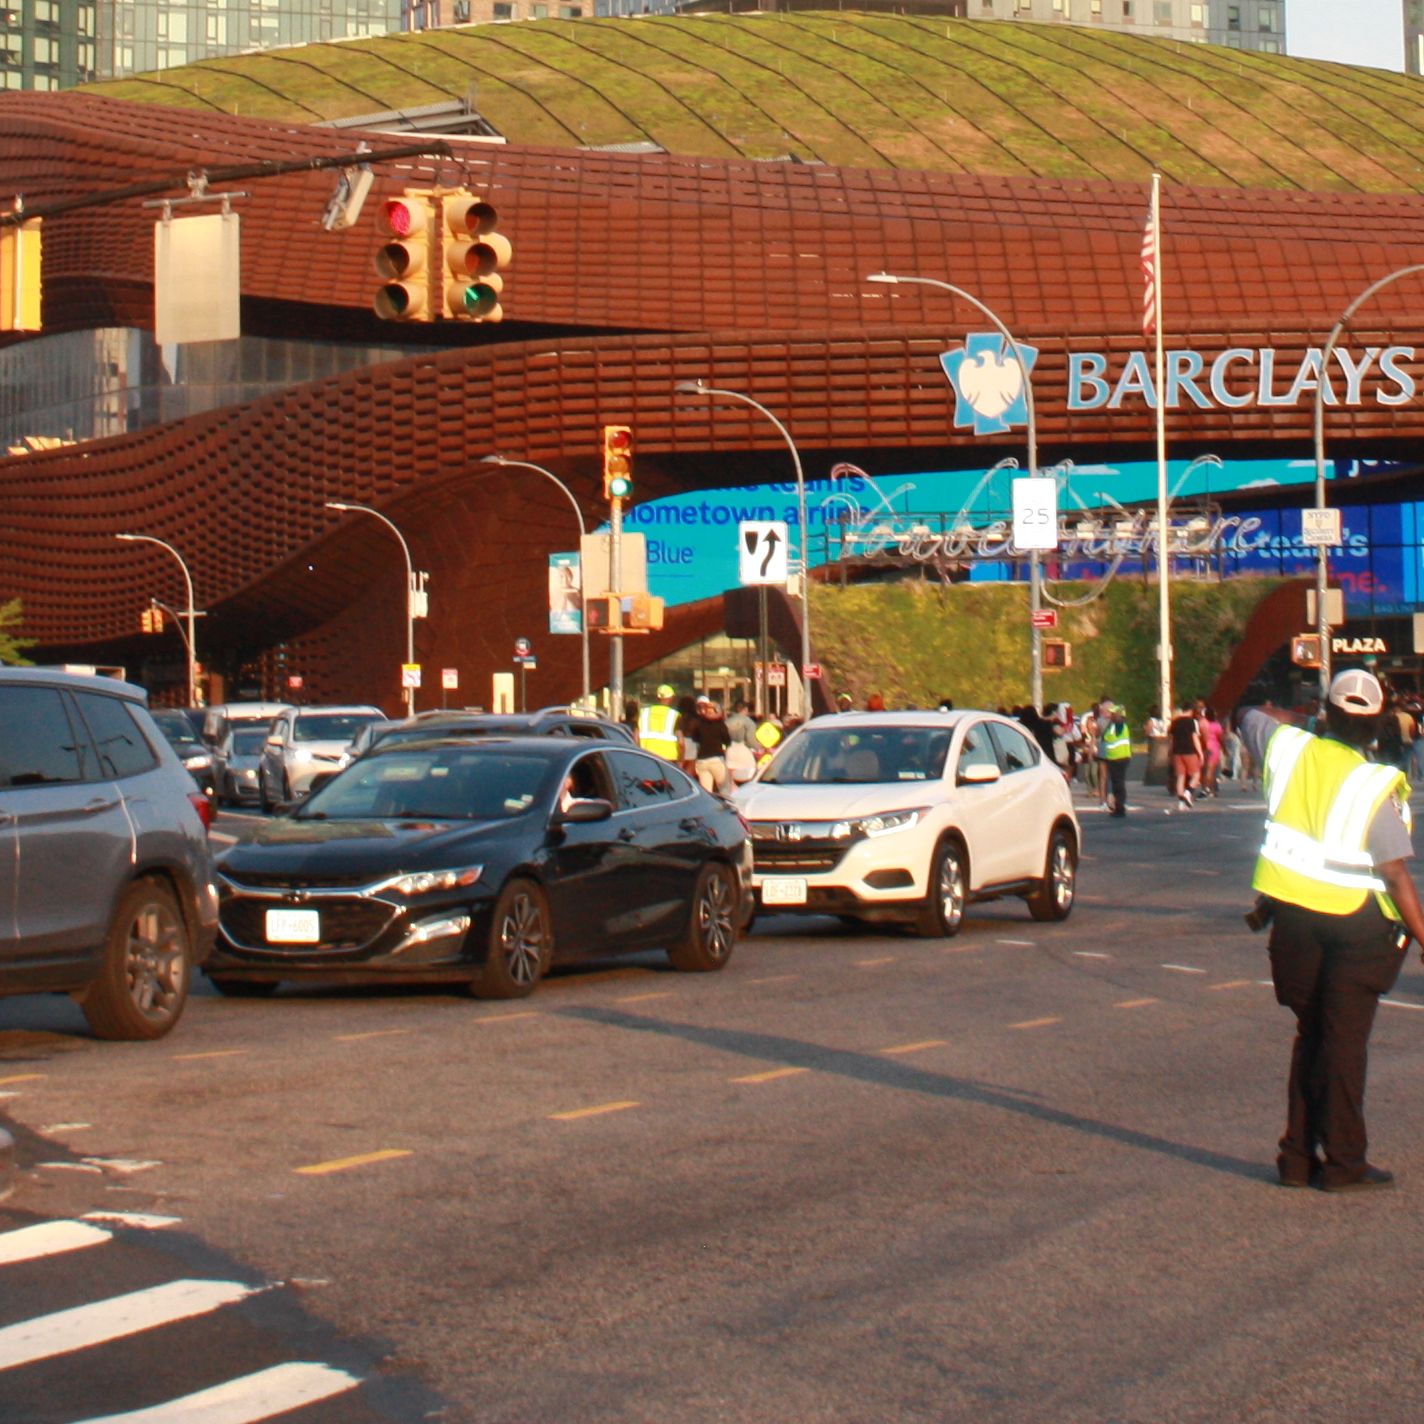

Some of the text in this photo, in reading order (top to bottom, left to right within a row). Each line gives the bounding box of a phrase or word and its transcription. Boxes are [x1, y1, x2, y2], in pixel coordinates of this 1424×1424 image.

[1067, 344, 1416, 411] BARCLAYS
[1022, 508, 1050, 525] 25
[1332, 637, 1387, 653] PLAZA
